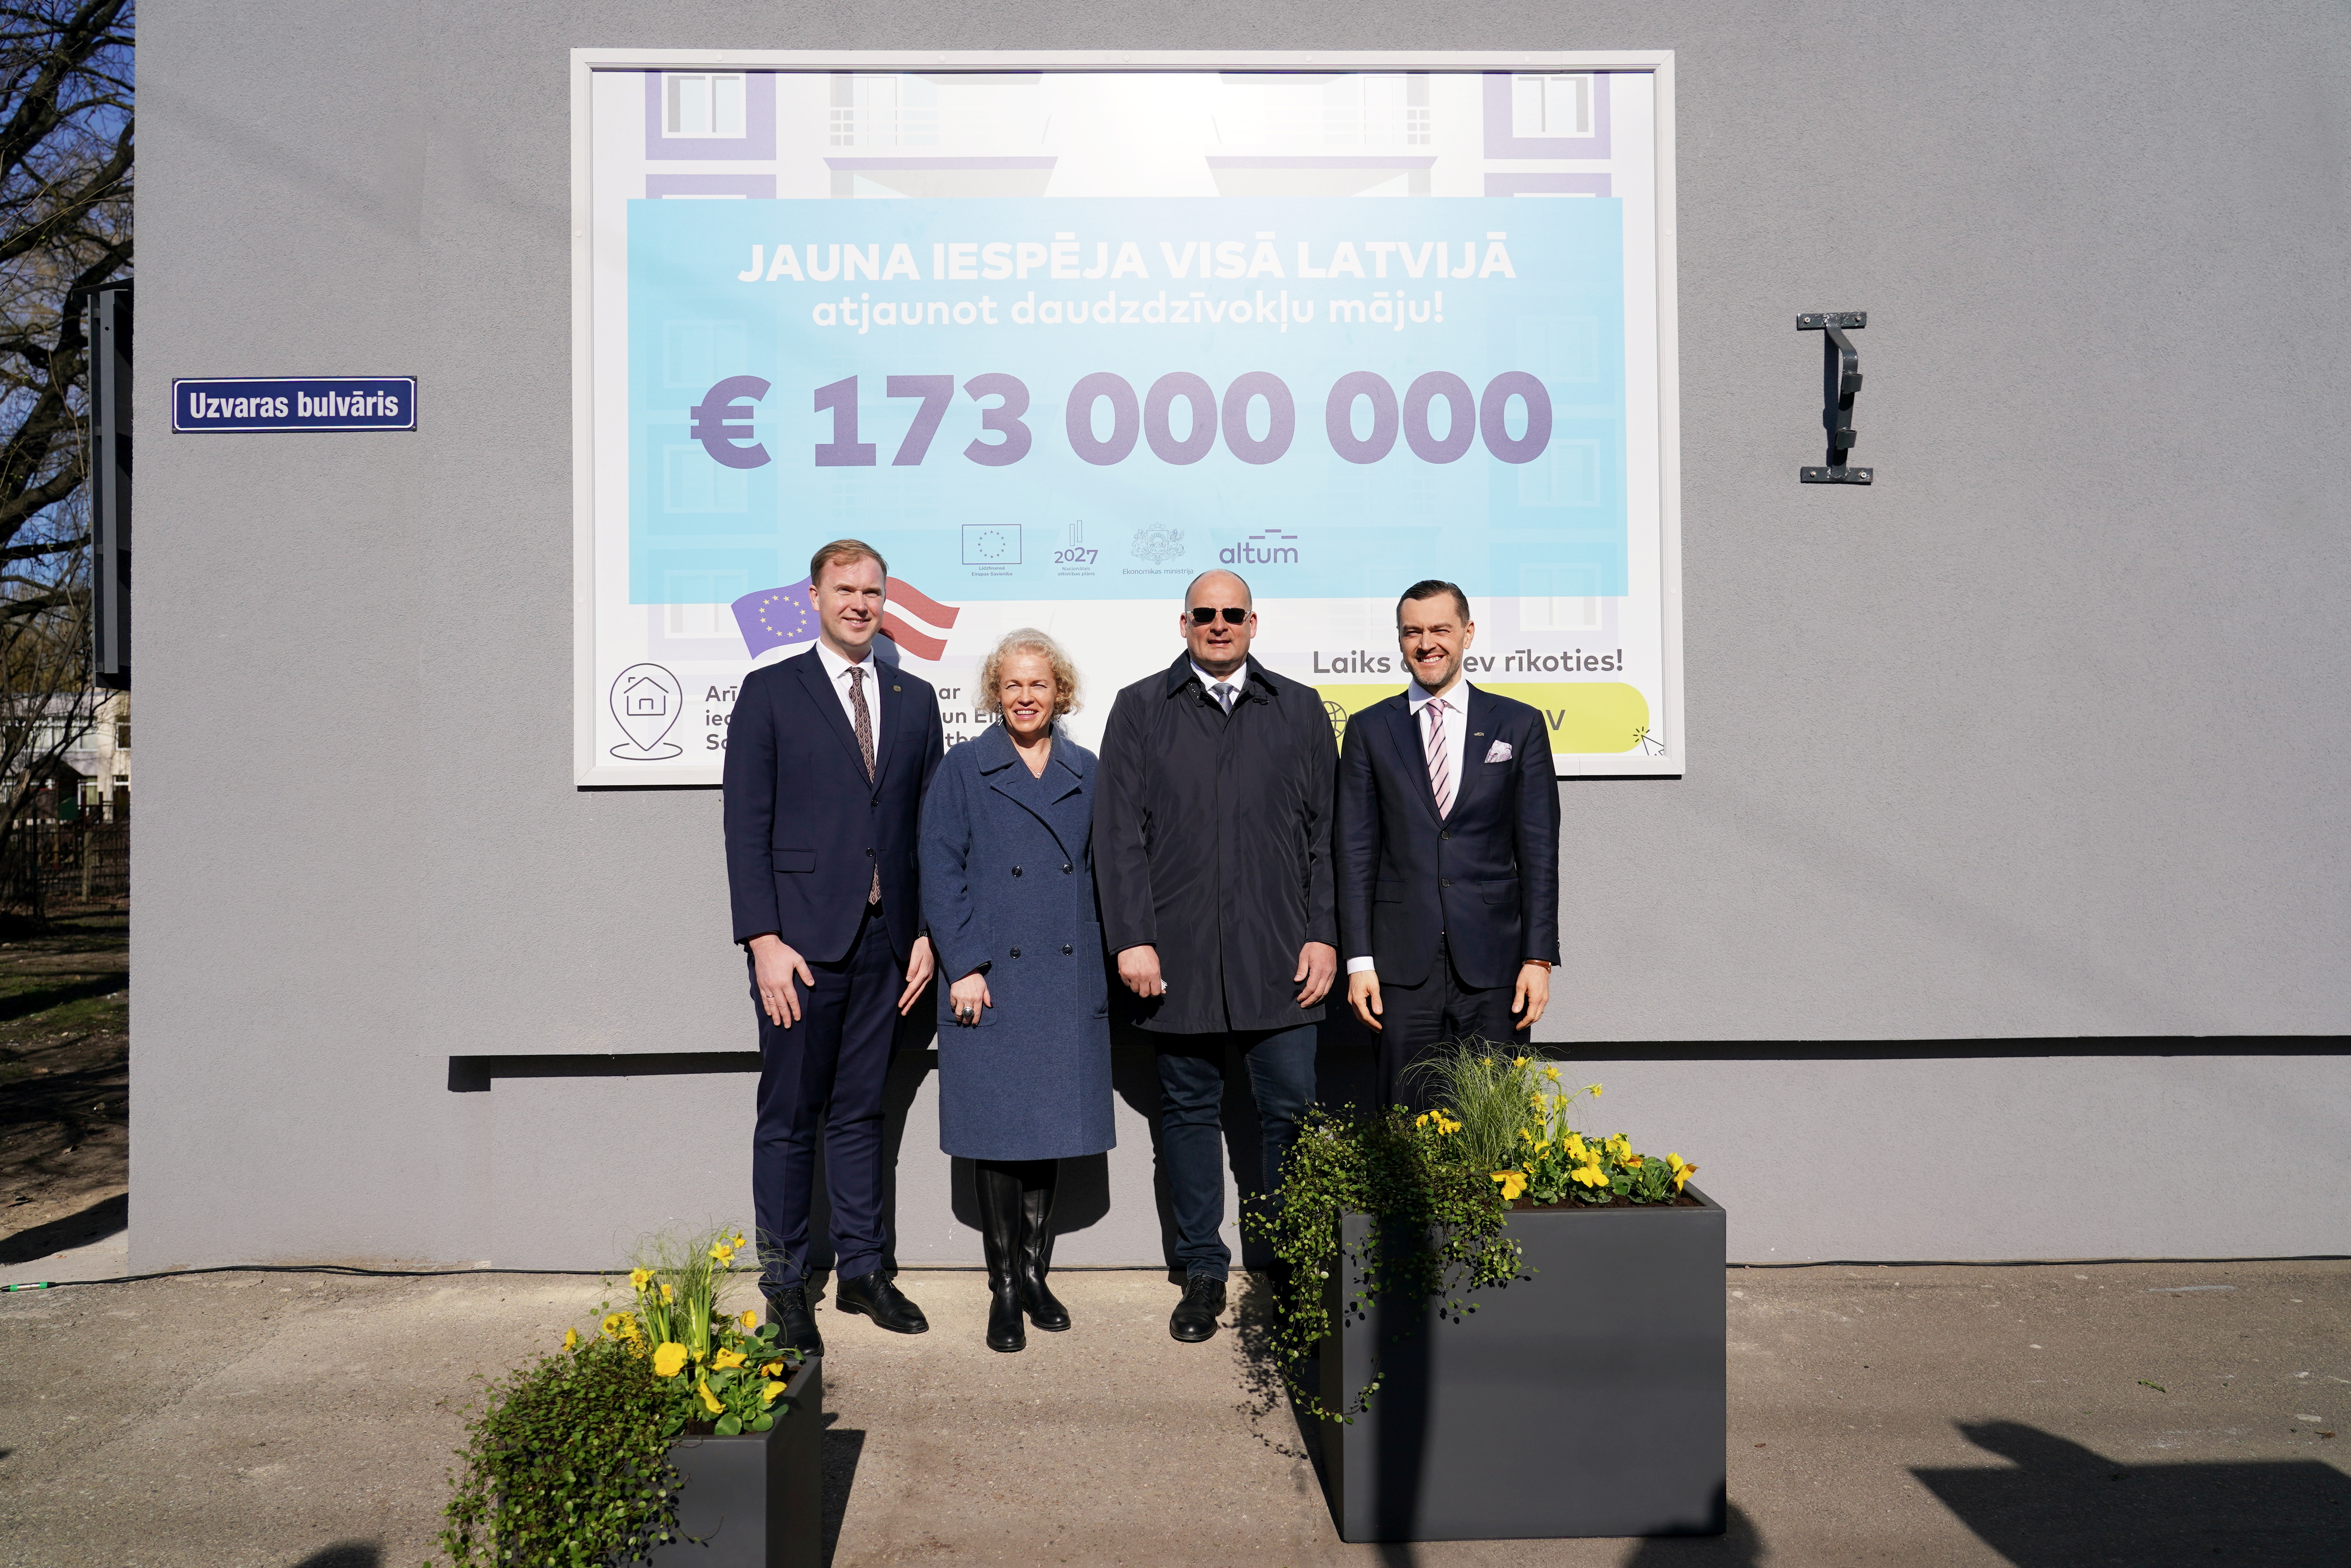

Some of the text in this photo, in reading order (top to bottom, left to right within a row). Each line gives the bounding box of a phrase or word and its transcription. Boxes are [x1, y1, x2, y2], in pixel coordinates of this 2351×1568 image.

[738, 231, 1516, 282] JAUNA IESPĒJA VISĀ LATVIJĀ
[812, 290, 1444, 334] atjaunot daudzdzīvokļu māju!
[190, 391, 398, 419] Uzvaras bulvāris
[691, 371, 1552, 469] € 173 000 000
[1054, 547, 1098, 564] 2027
[1219, 542, 1298, 564] altum
[1314, 650, 1390, 674] Laiks
[1506, 649, 1623, 671] rīkoties!
